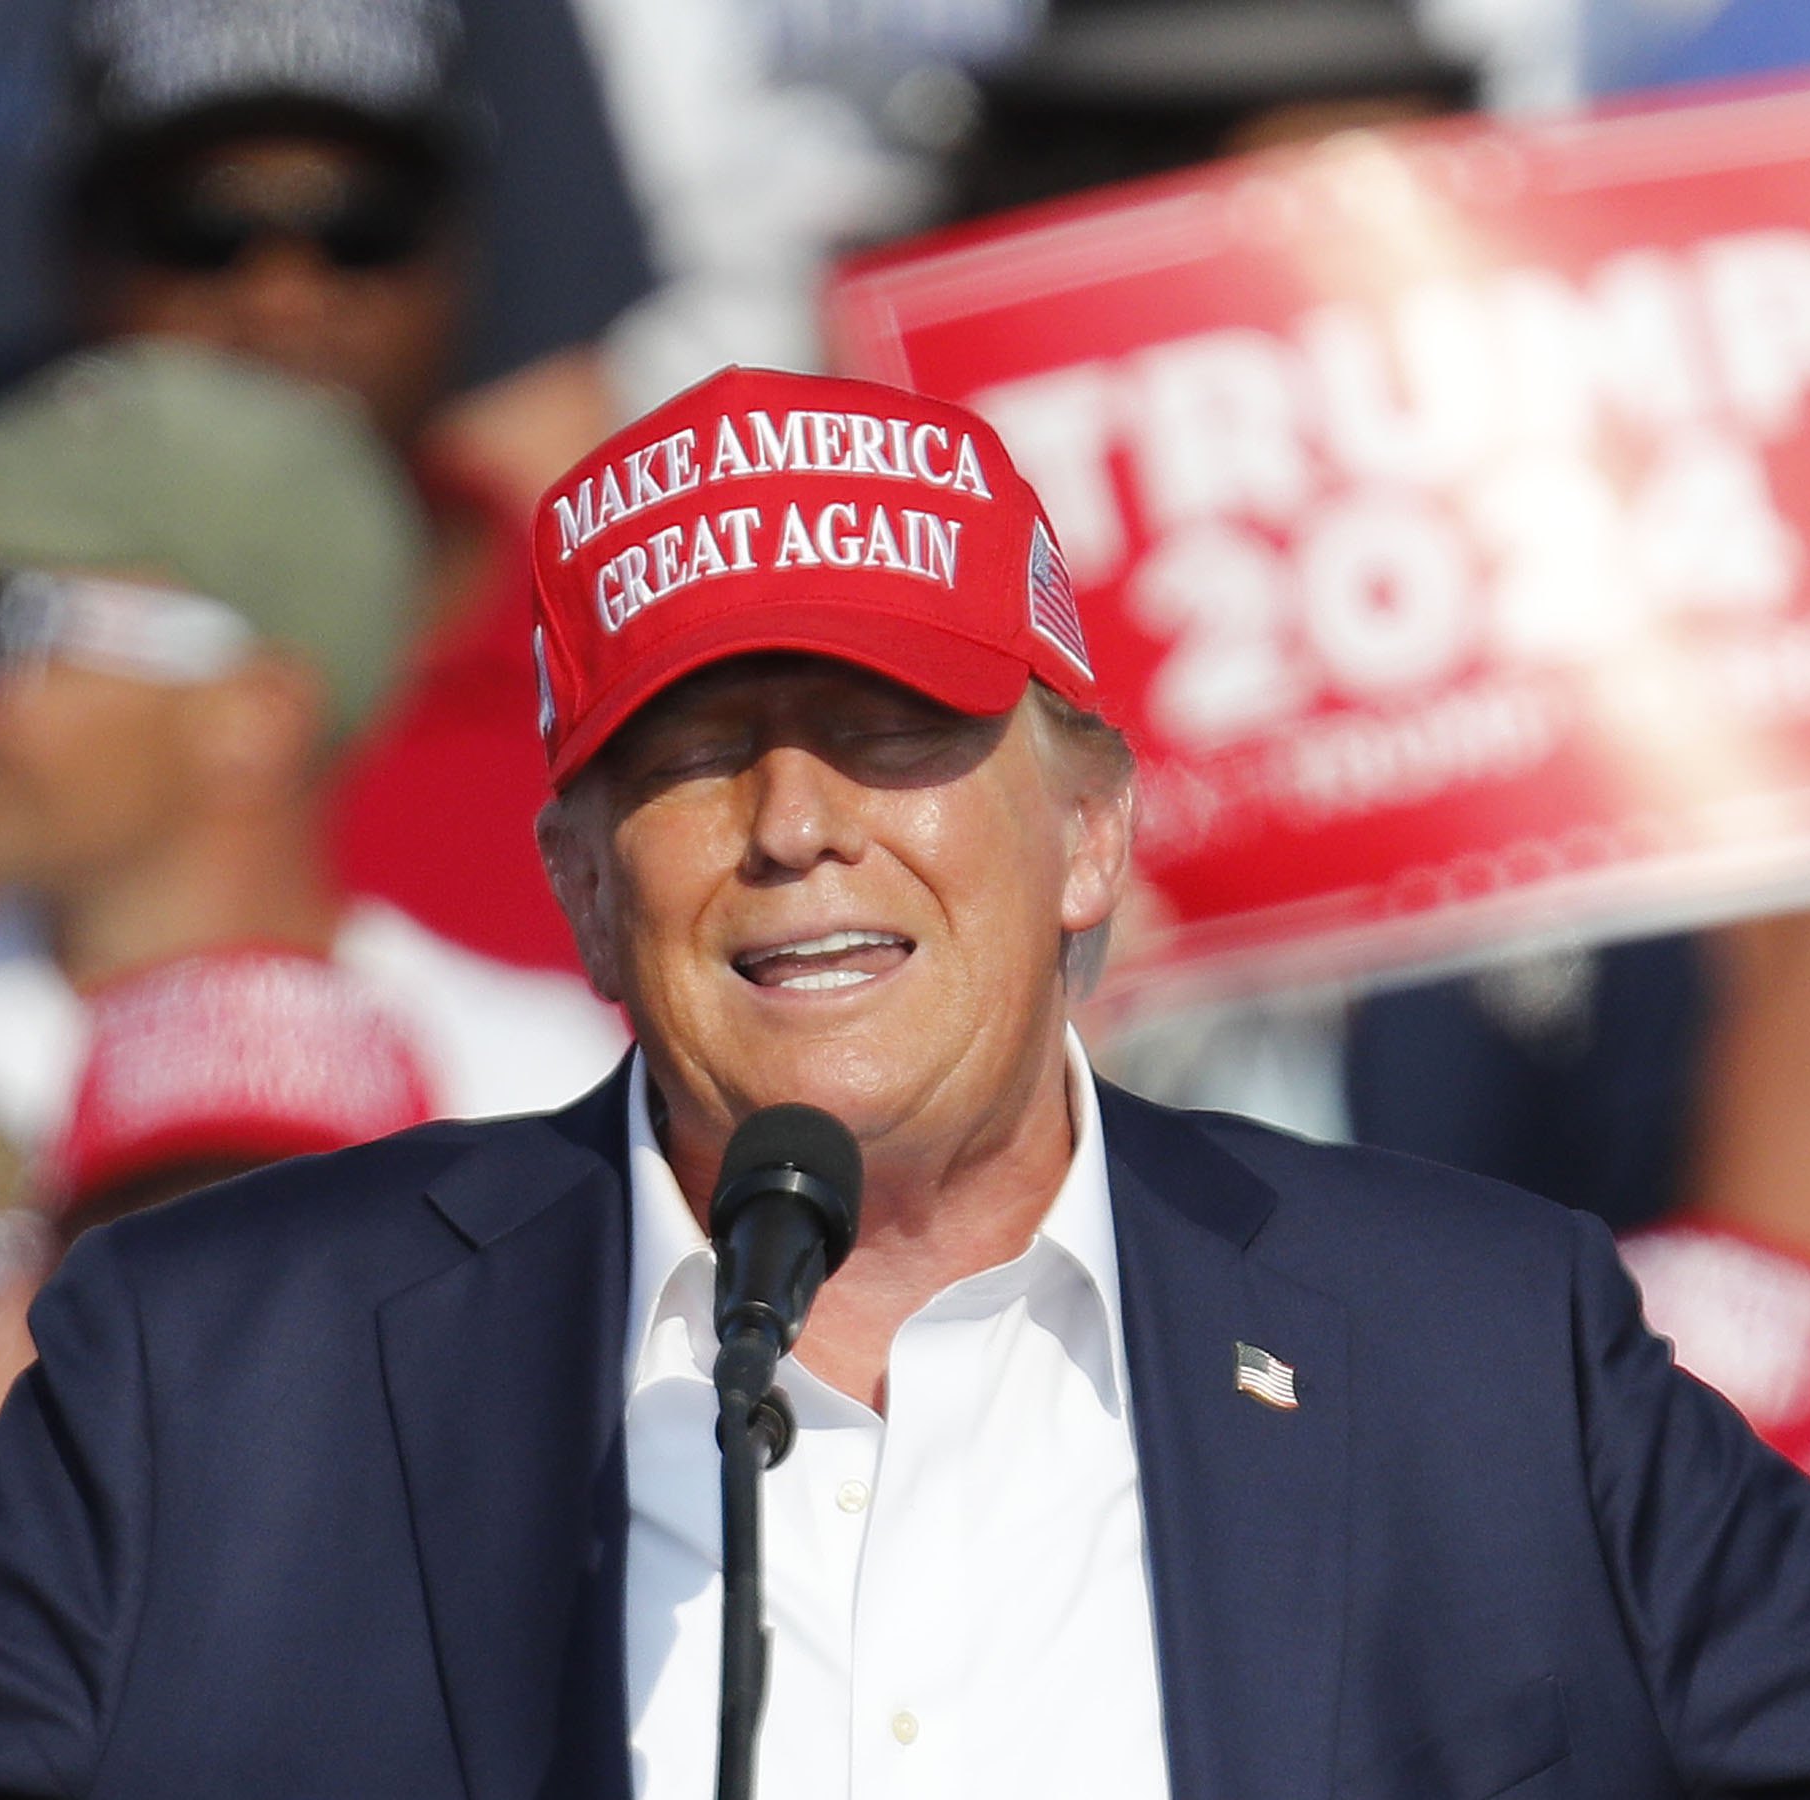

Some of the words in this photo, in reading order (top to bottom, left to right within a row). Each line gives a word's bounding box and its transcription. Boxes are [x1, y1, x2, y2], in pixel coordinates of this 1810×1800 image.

[553, 428, 702, 561] MAKE
[709, 410, 992, 500] AMERICA
[595, 506, 760, 635] GREAT
[775, 502, 961, 590] AGAIN
